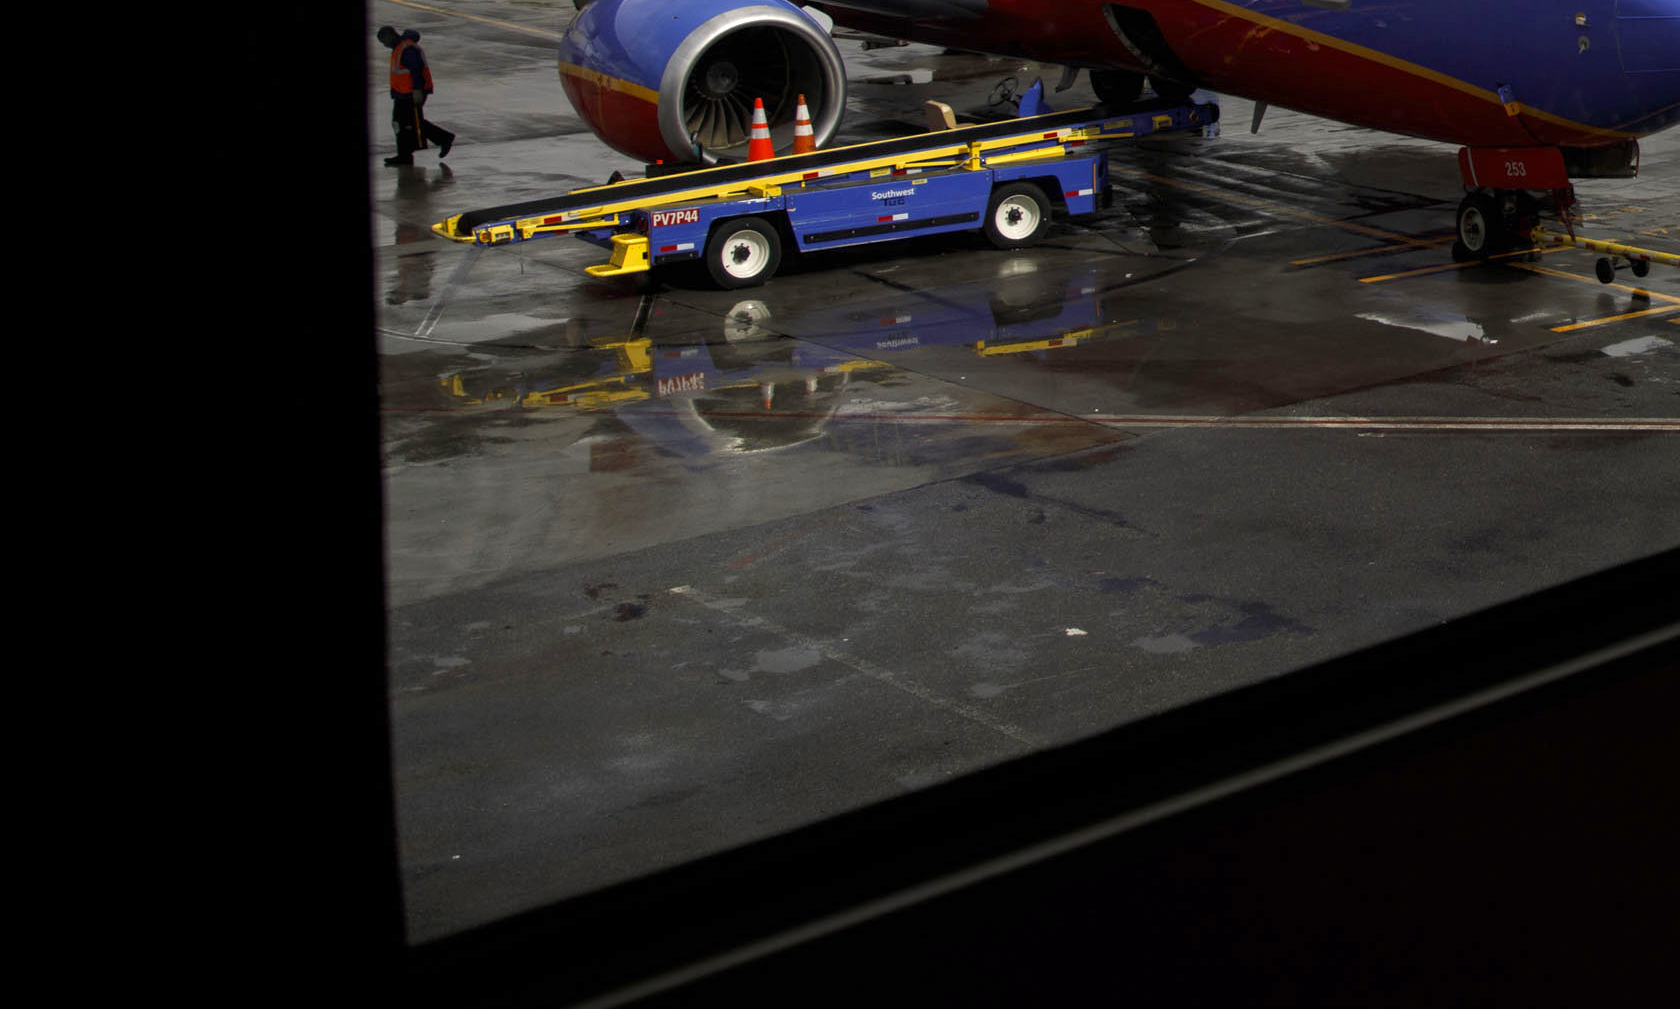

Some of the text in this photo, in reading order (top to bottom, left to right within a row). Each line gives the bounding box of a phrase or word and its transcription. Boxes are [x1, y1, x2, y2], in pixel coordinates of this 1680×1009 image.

[1504, 161, 1527, 177] 253
[871, 188, 915, 200] Southwest
[653, 210, 699, 227] PV7P44
